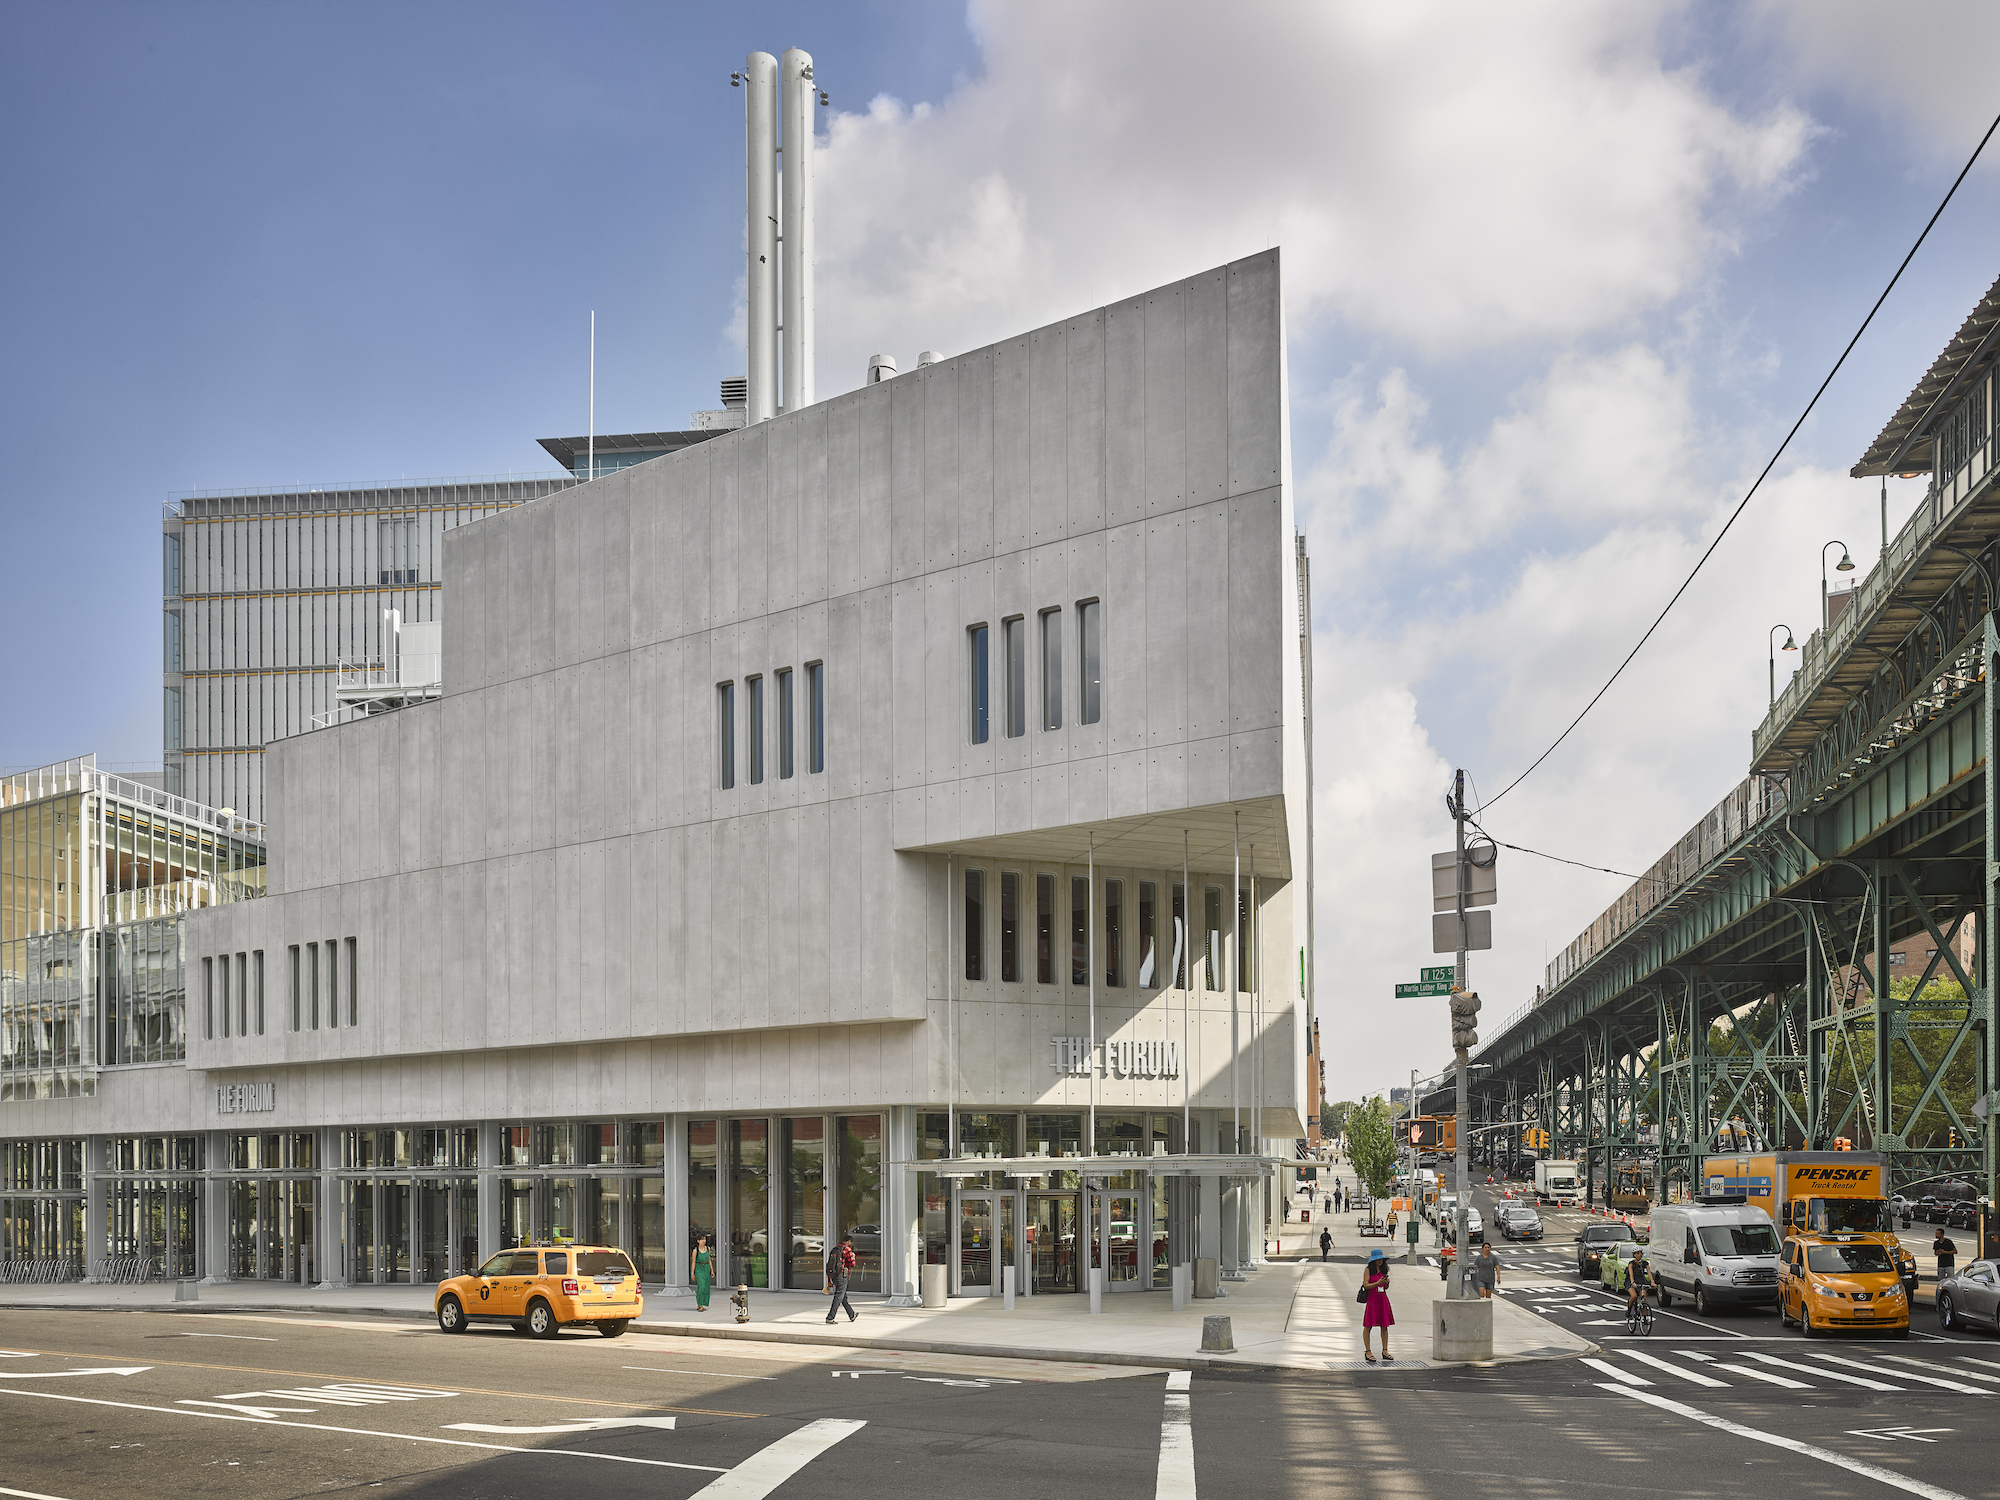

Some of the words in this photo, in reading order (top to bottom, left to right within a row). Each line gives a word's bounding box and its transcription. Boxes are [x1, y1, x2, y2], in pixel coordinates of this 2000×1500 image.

[1423, 970, 1429, 980] W
[1432, 969, 1445, 980] 125
[1404, 984, 1419, 992] Martin
[1437, 983, 1447, 992] King
[1051, 1036, 1092, 1074] THE
[1105, 1037, 1182, 1076] FORUM
[214, 1085, 234, 1113] THE
[236, 1082, 274, 1112] FORUM
[1795, 1168, 1872, 1180] PENSKE
[1811, 1181, 1831, 1189] Truck
